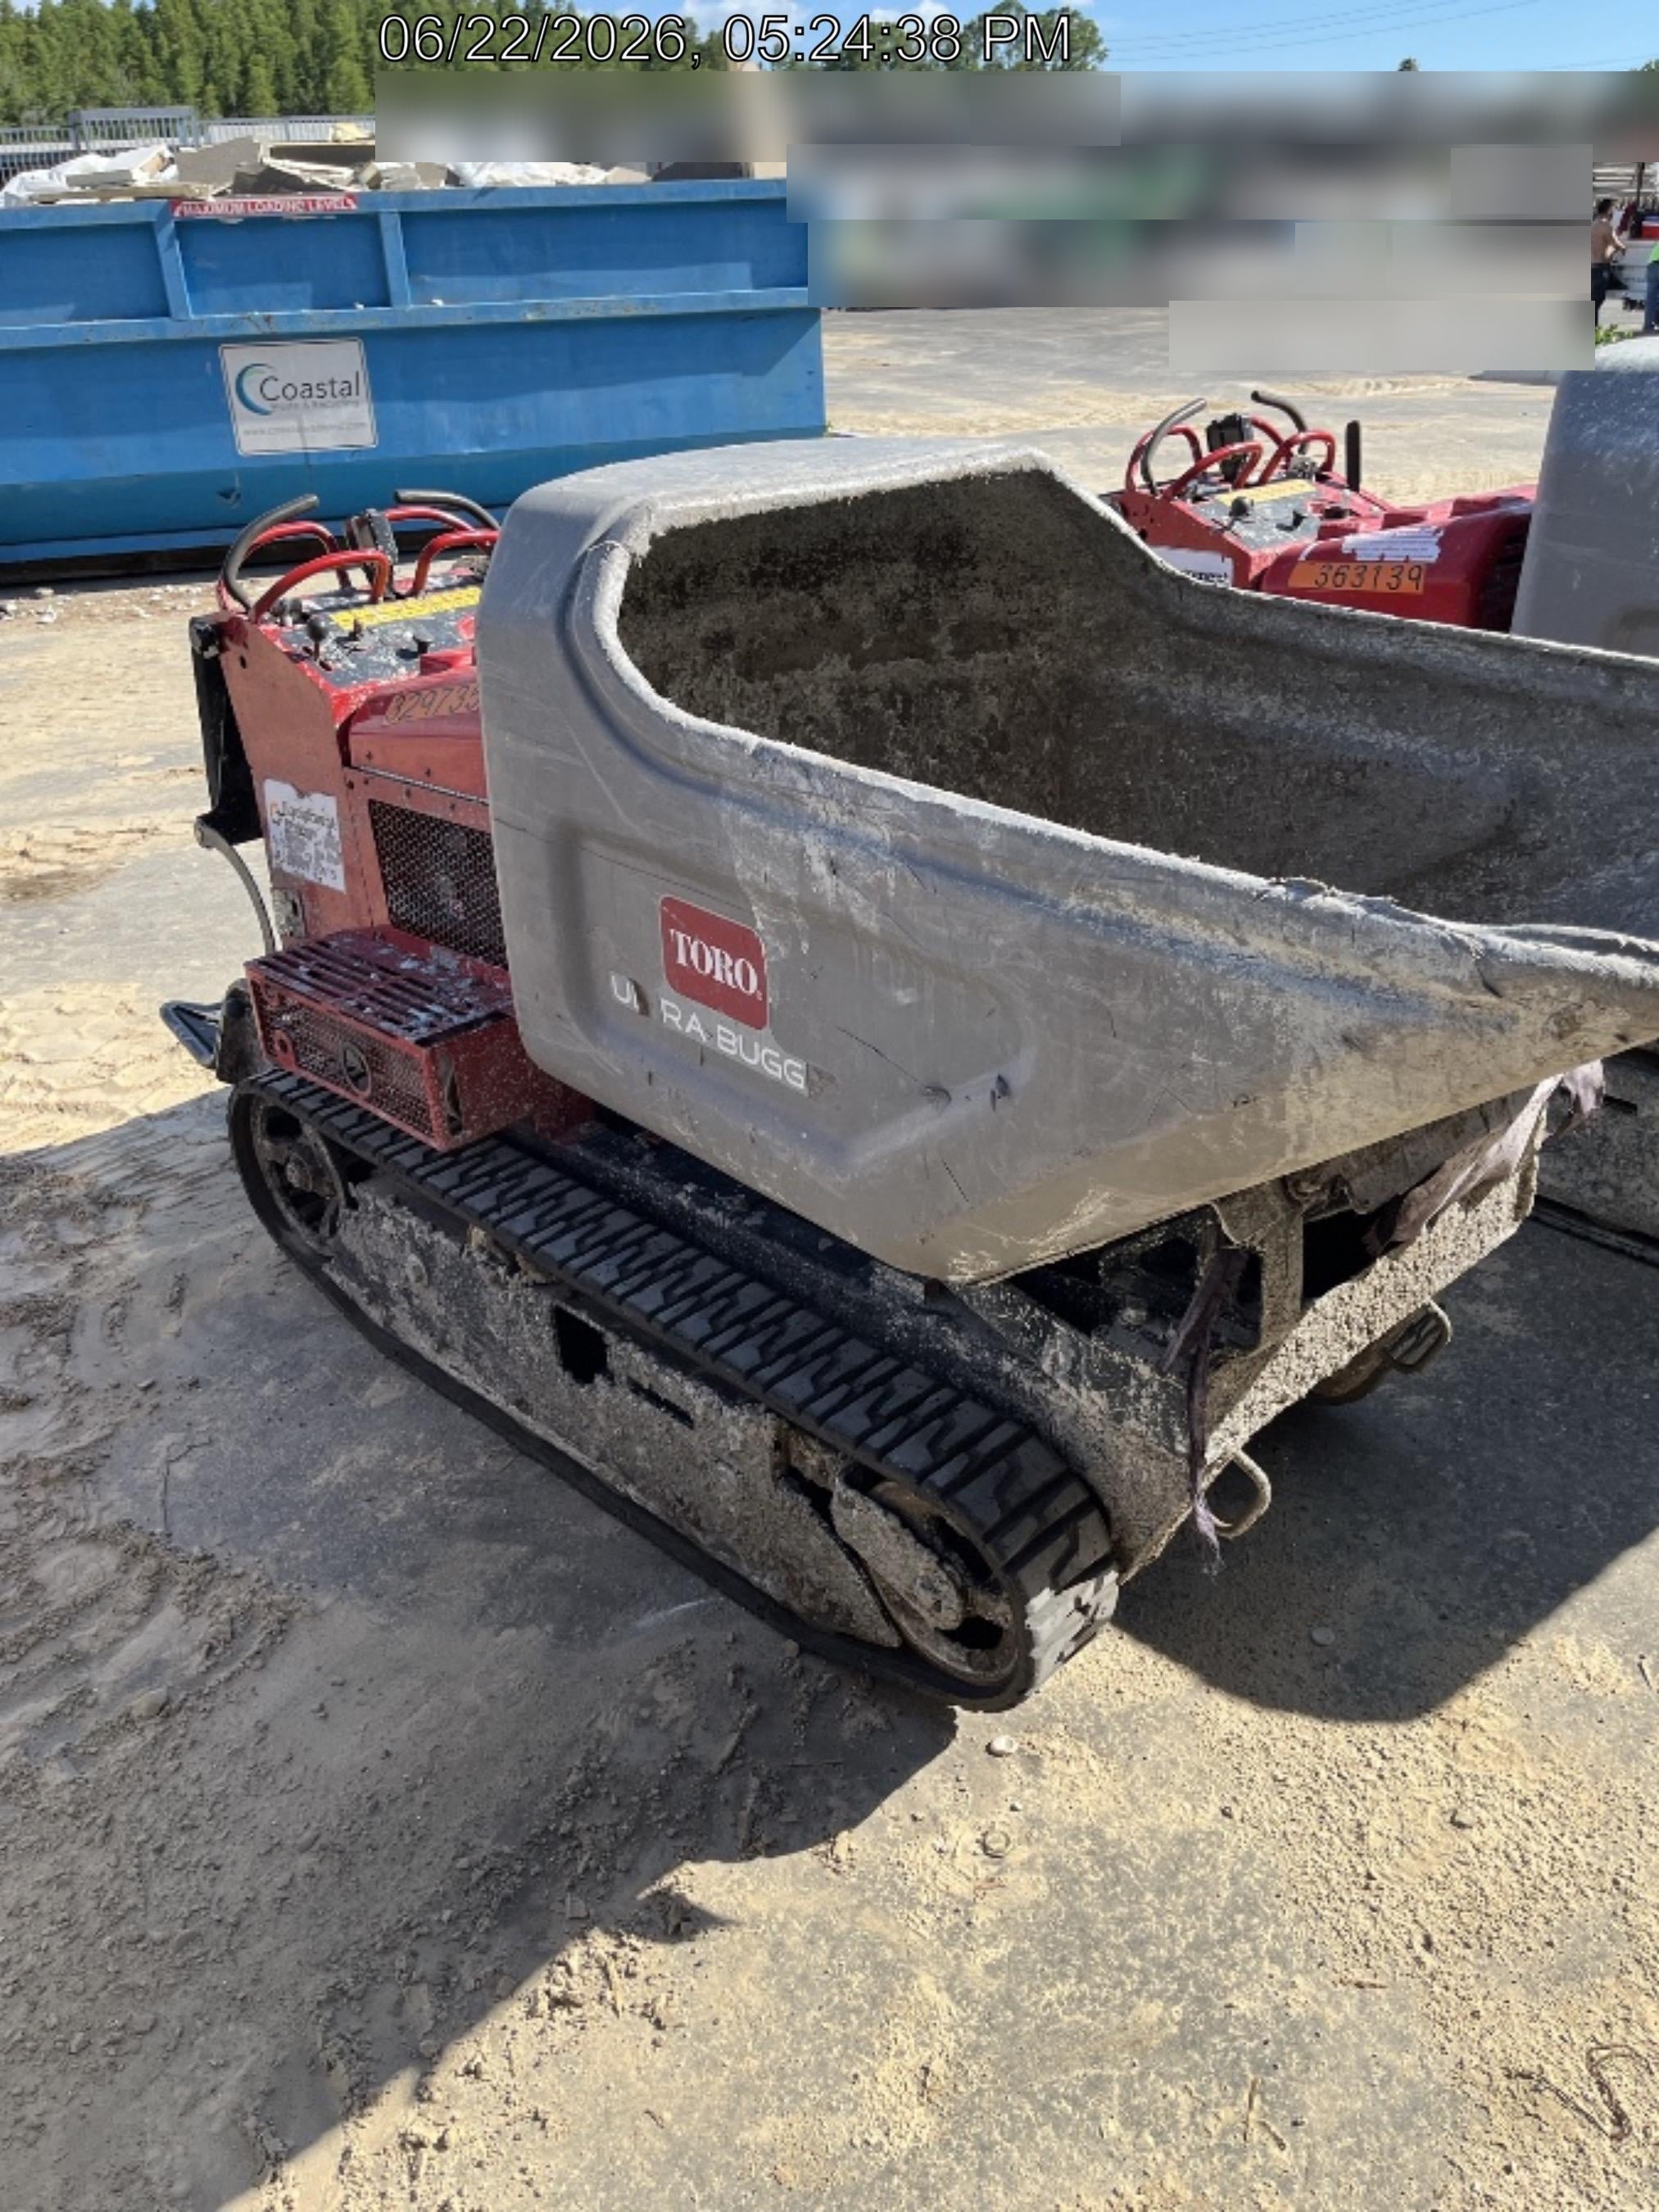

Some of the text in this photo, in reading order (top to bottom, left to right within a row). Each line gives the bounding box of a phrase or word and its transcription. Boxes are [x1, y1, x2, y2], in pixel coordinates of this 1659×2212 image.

[247, 199, 305, 214] LOADING
[260, 370, 360, 401] Coastal
[1315, 564, 1424, 591] 363139
[669, 928, 759, 995] TORO
